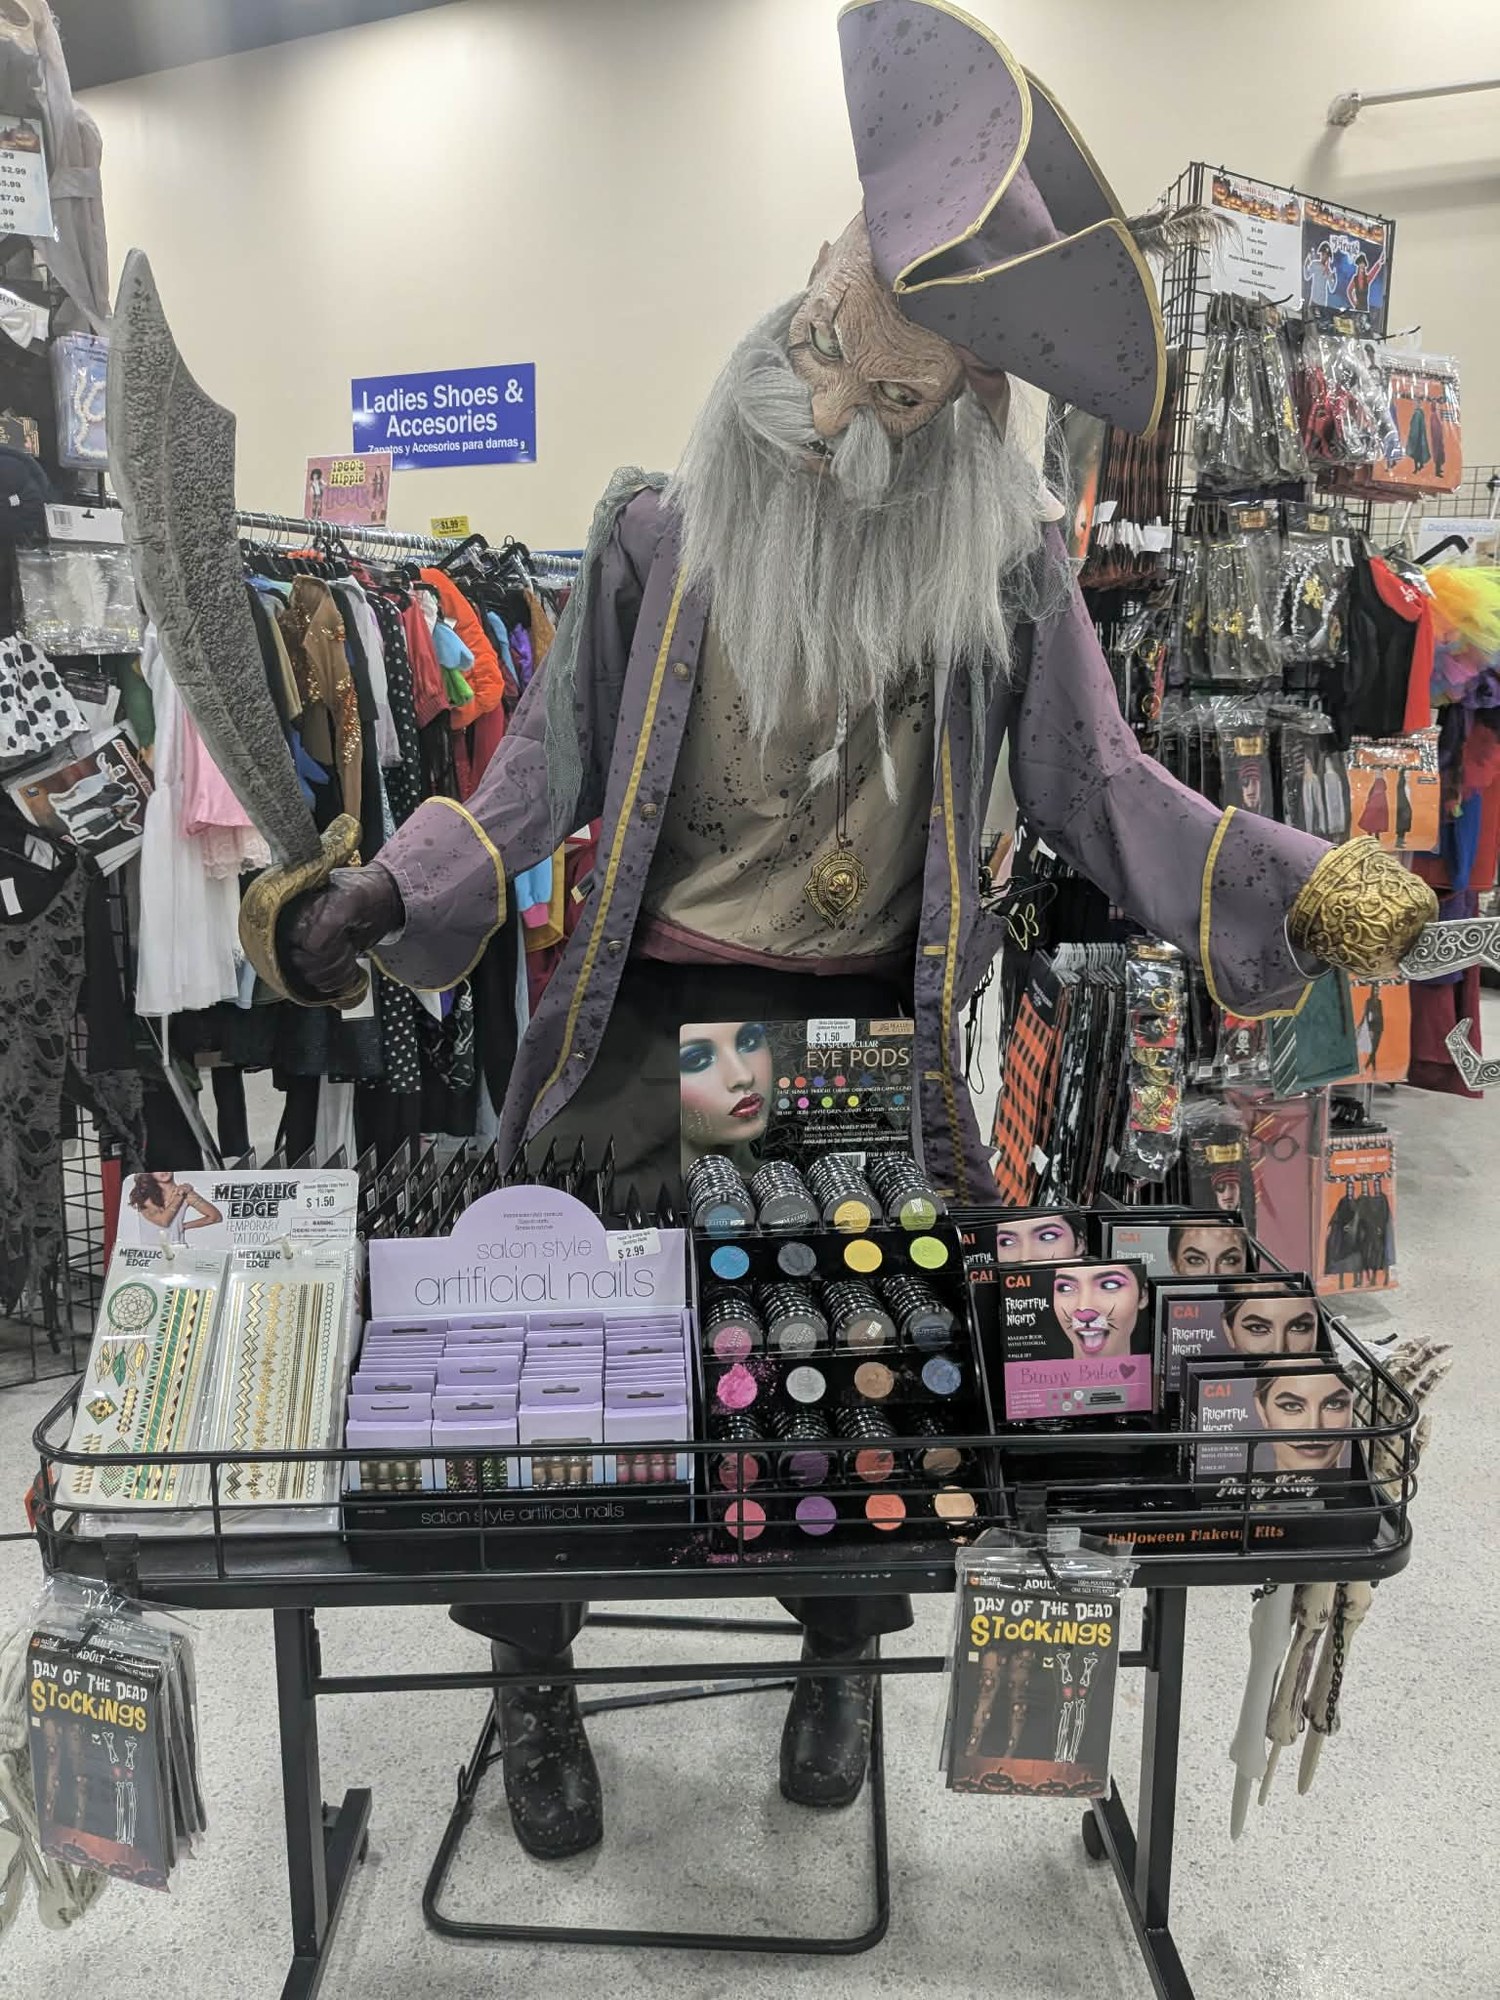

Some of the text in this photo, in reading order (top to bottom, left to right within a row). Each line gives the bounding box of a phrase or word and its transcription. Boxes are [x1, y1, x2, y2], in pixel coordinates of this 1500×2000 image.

[362, 379, 524, 414] Ladies Shoes &
[386, 409, 498, 438] Accesories
[405, 446, 411, 456] y
[412, 441, 460, 454] Accesorios
[463, 440, 484, 452] para
[485, 437, 518, 449] damas
[333, 461, 364, 472] 1960's
[441, 520, 459, 529] $1.99
[816, 1032, 840, 1042] $ 1.50
[828, 1040, 879, 1049] SPECTACULAR
[806, 1048, 910, 1068] EYE PODS
[213, 1181, 299, 1200] METALLIC
[306, 1196, 335, 1208] $ 1.50
[229, 1202, 279, 1218] EDGE
[226, 1220, 280, 1232] TEMPORARY
[233, 1232, 270, 1245] TATTOOS
[961, 1233, 976, 1245] AI
[1117, 1233, 1141, 1243] CAI
[119, 1248, 163, 1260] METALLIC
[238, 1251, 281, 1260] METALLIC
[477, 1237, 537, 1260] salon
[542, 1234, 592, 1262] style
[617, 1244, 645, 1260] $ 2.99
[126, 1259, 151, 1268] EDGE
[246, 1260, 270, 1269] EDGE
[965, 1251, 995, 1265] GHTFUL
[415, 1260, 655, 1306] artificial nails
[969, 1270, 993, 1282] CAI
[1005, 1275, 1031, 1289] CAI
[1005, 1297, 1050, 1312] FRIGHTFUL
[1006, 1312, 1036, 1326] NIGHTS
[1173, 1305, 1200, 1320] CAI
[1171, 1327, 1217, 1343] FRIGHTFUL
[1171, 1344, 1202, 1355] NIGHTS
[1020, 1363, 1118, 1387] Bunny Babe
[1203, 1383, 1232, 1398] CAI
[1202, 1407, 1249, 1422] FRIGHTFUL
[421, 1509, 471, 1525] salon
[519, 1503, 582, 1521] artificial
[586, 1501, 625, 1519] nails
[1107, 1531, 1185, 1546] Halloween
[1254, 1525, 1285, 1538] Kits
[973, 1596, 1113, 1621] DAY OF THE DEAD
[76, 1649, 105, 1665] ADULT
[32, 1659, 148, 1702] DAY OF THE DEAD
